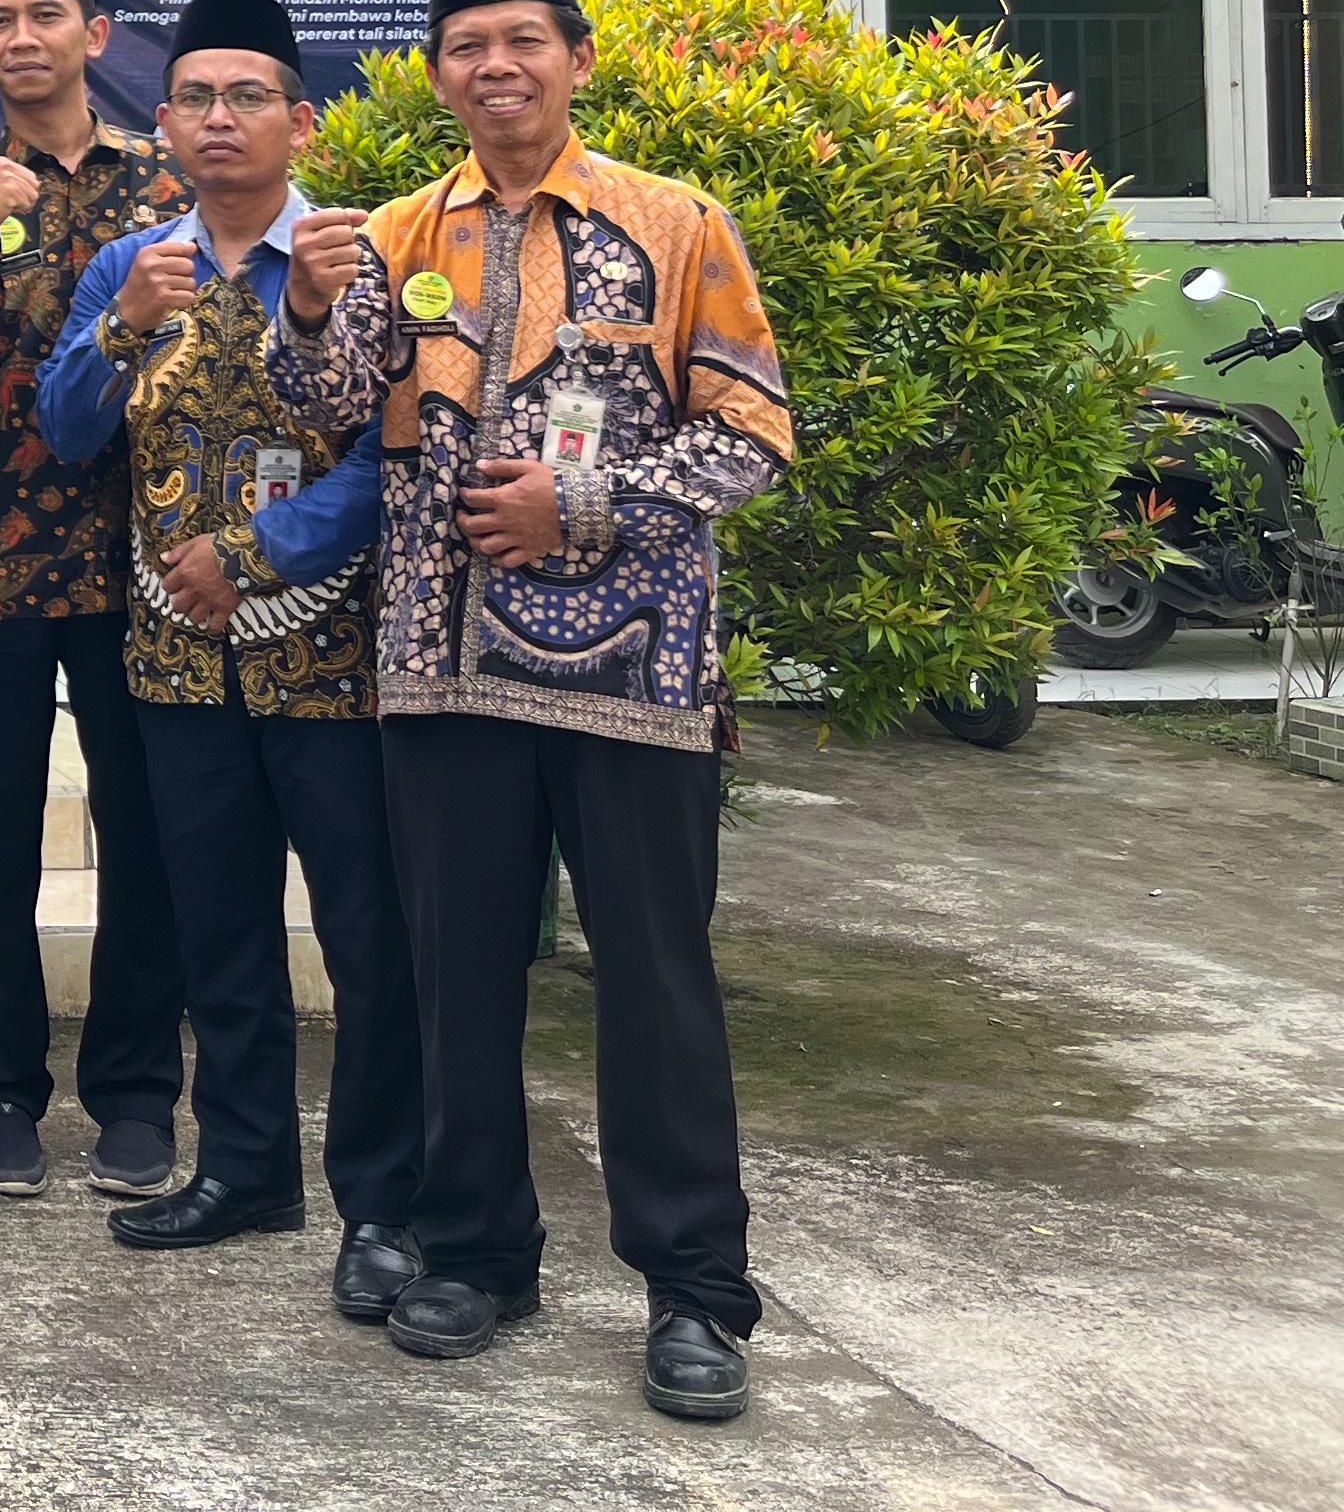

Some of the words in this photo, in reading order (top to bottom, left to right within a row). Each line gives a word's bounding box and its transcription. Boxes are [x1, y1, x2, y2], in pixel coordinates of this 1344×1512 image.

[114, 9, 180, 26] Semoga
[308, 8, 392, 23] membawa
[292, 28, 355, 44] pererat
[357, 26, 383, 40] tali
[385, 26, 428, 40] silatu
